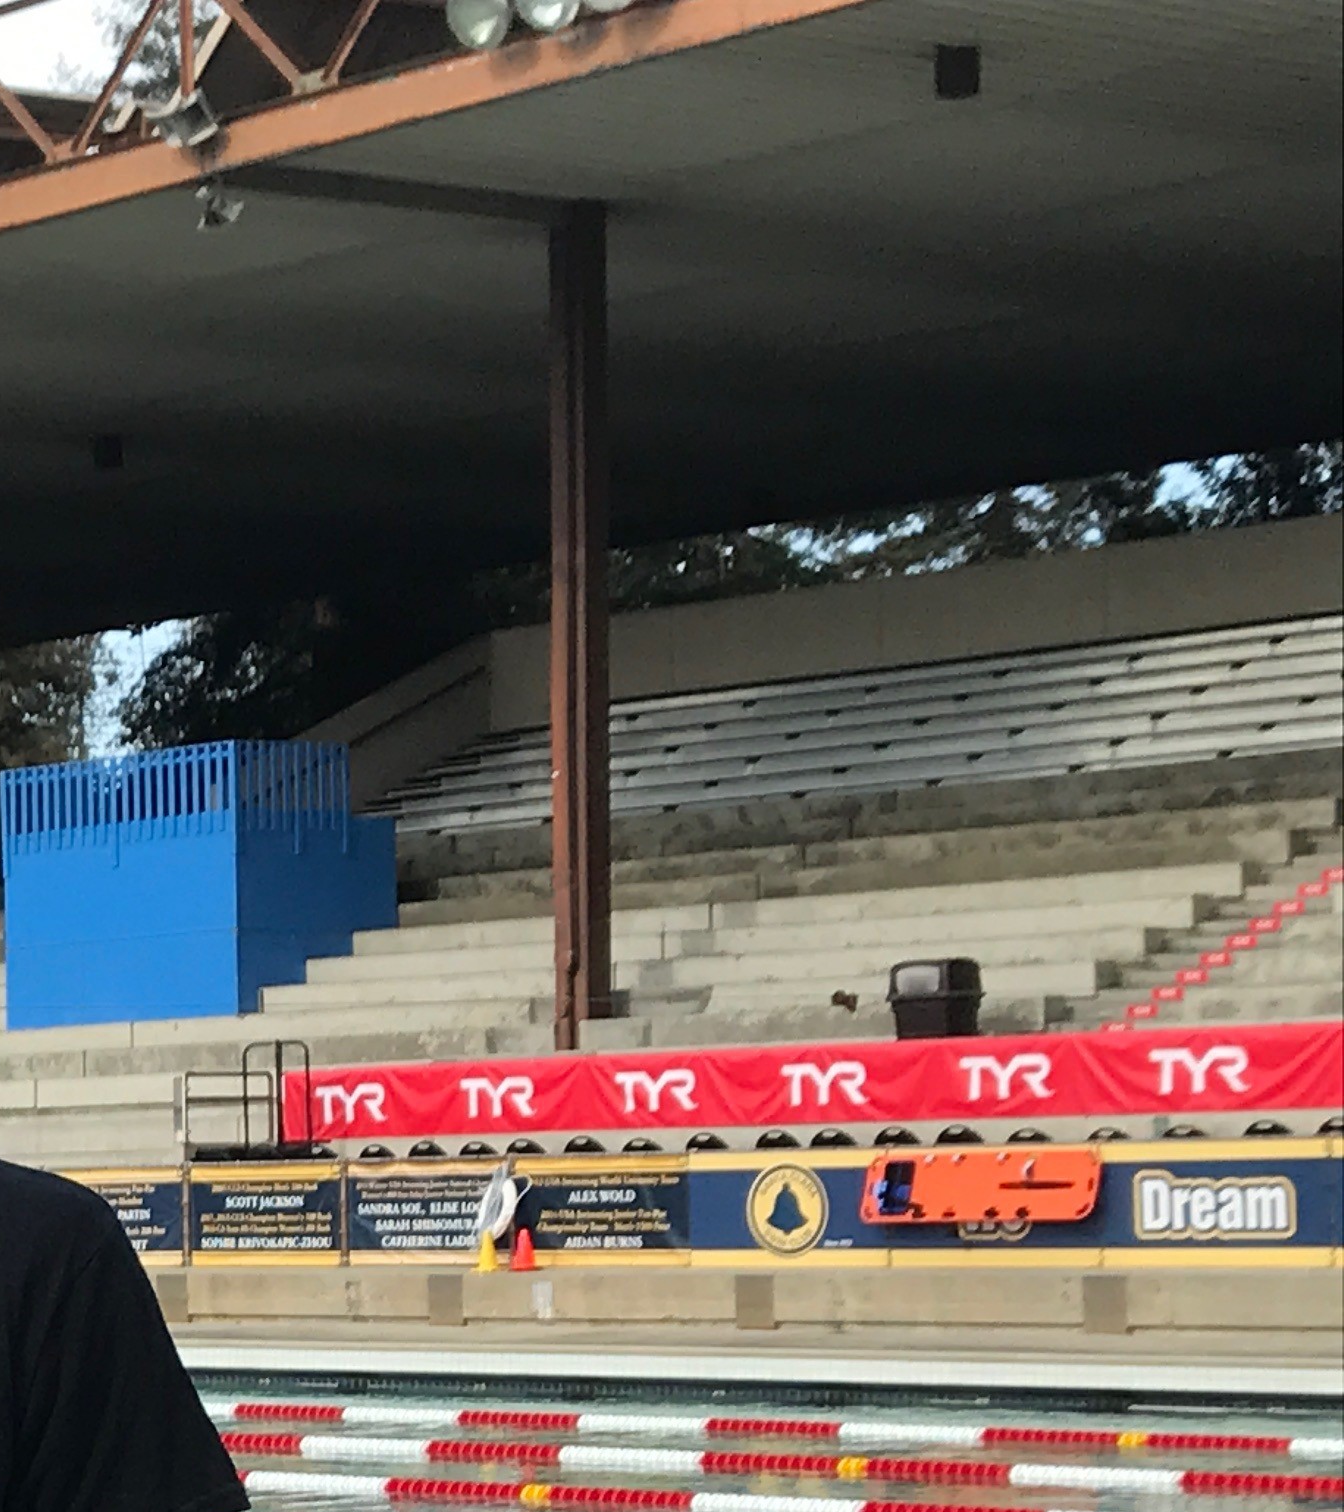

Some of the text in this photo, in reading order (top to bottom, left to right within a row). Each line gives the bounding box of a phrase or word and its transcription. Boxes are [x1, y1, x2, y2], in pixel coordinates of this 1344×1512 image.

[315, 1045, 1251, 1126] TYR TYR TYR TYR TYR TYR
[225, 1195, 305, 1210] SCOTT JACKSON
[567, 1189, 637, 1204] ALEX WOLD
[1141, 1179, 1289, 1231] Dream
